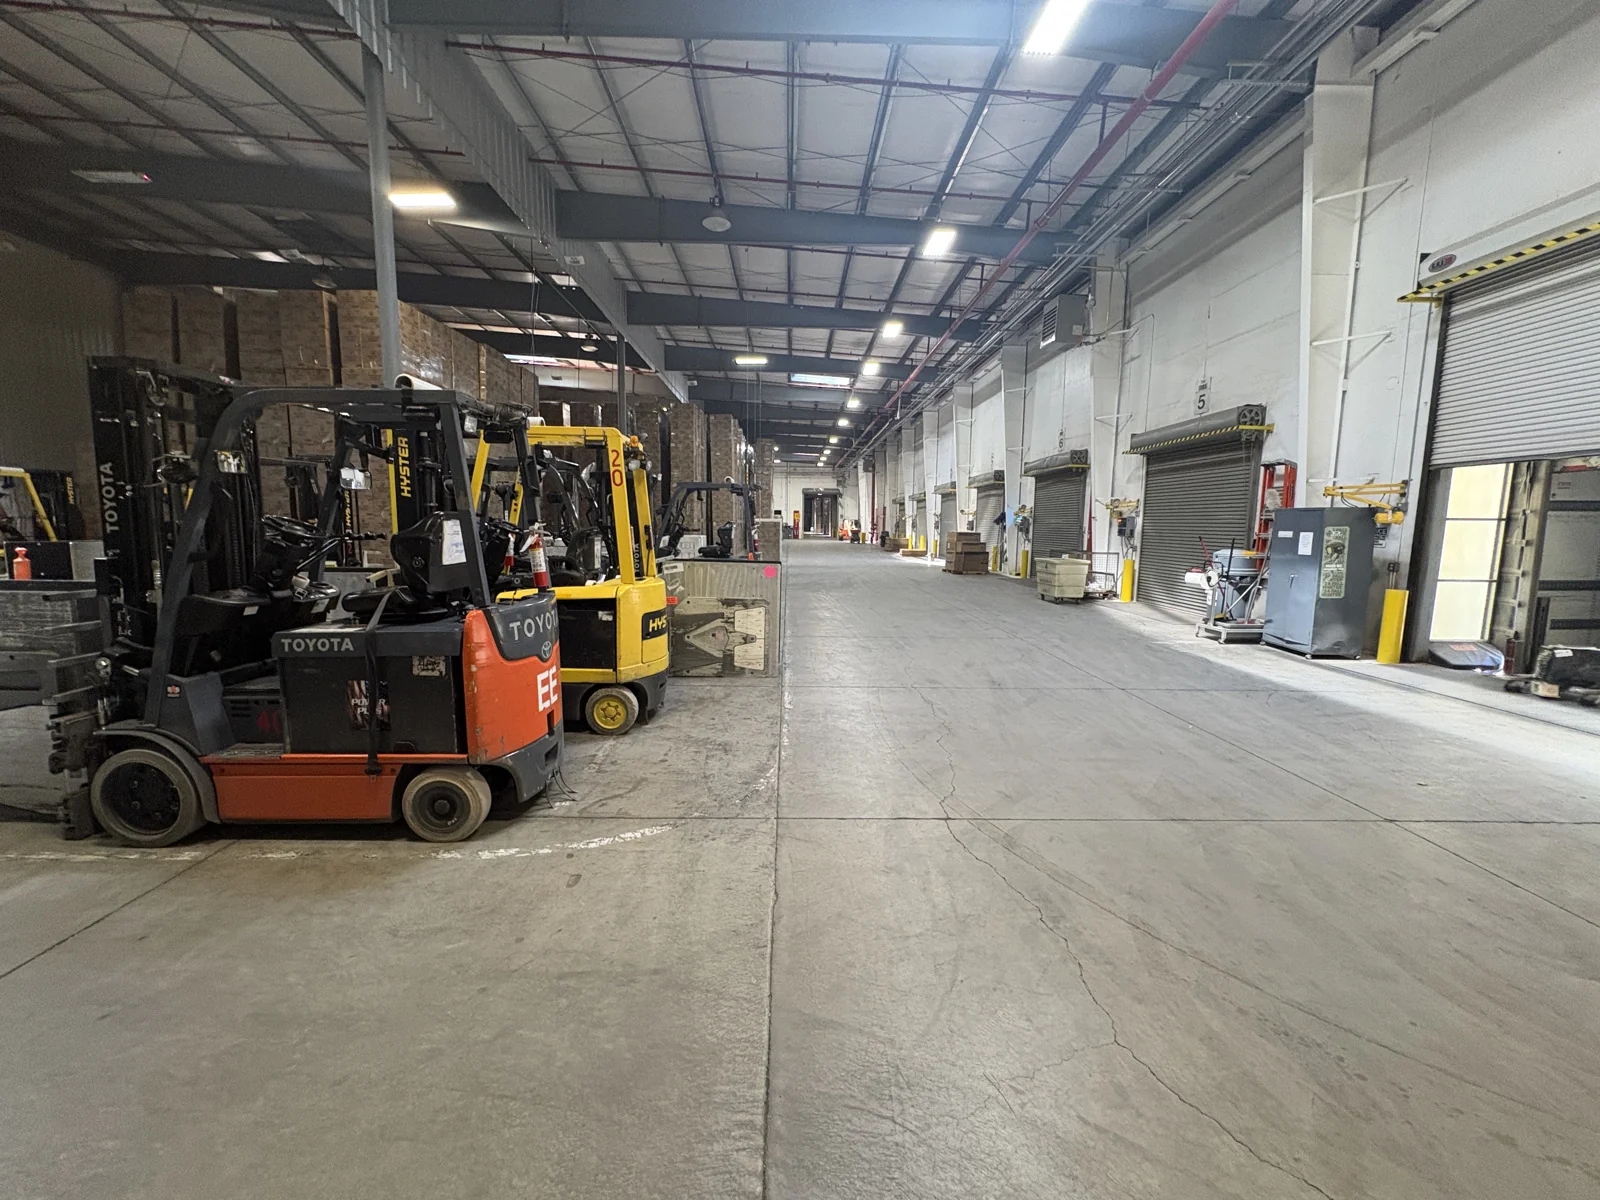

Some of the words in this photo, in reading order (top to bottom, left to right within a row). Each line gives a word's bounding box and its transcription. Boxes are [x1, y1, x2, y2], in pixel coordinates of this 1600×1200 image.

[1197, 393, 1206, 410] 5
[1058, 438, 1064, 448] 6
[397, 436, 411, 498] HYSTER
[610, 449, 624, 487] 20
[99, 462, 120, 534] TOYOTA
[280, 637, 355, 653] TOYOTA
[536, 664, 559, 713] EE
[351, 698, 387, 706] POWR
[357, 706, 383, 715] PLS
